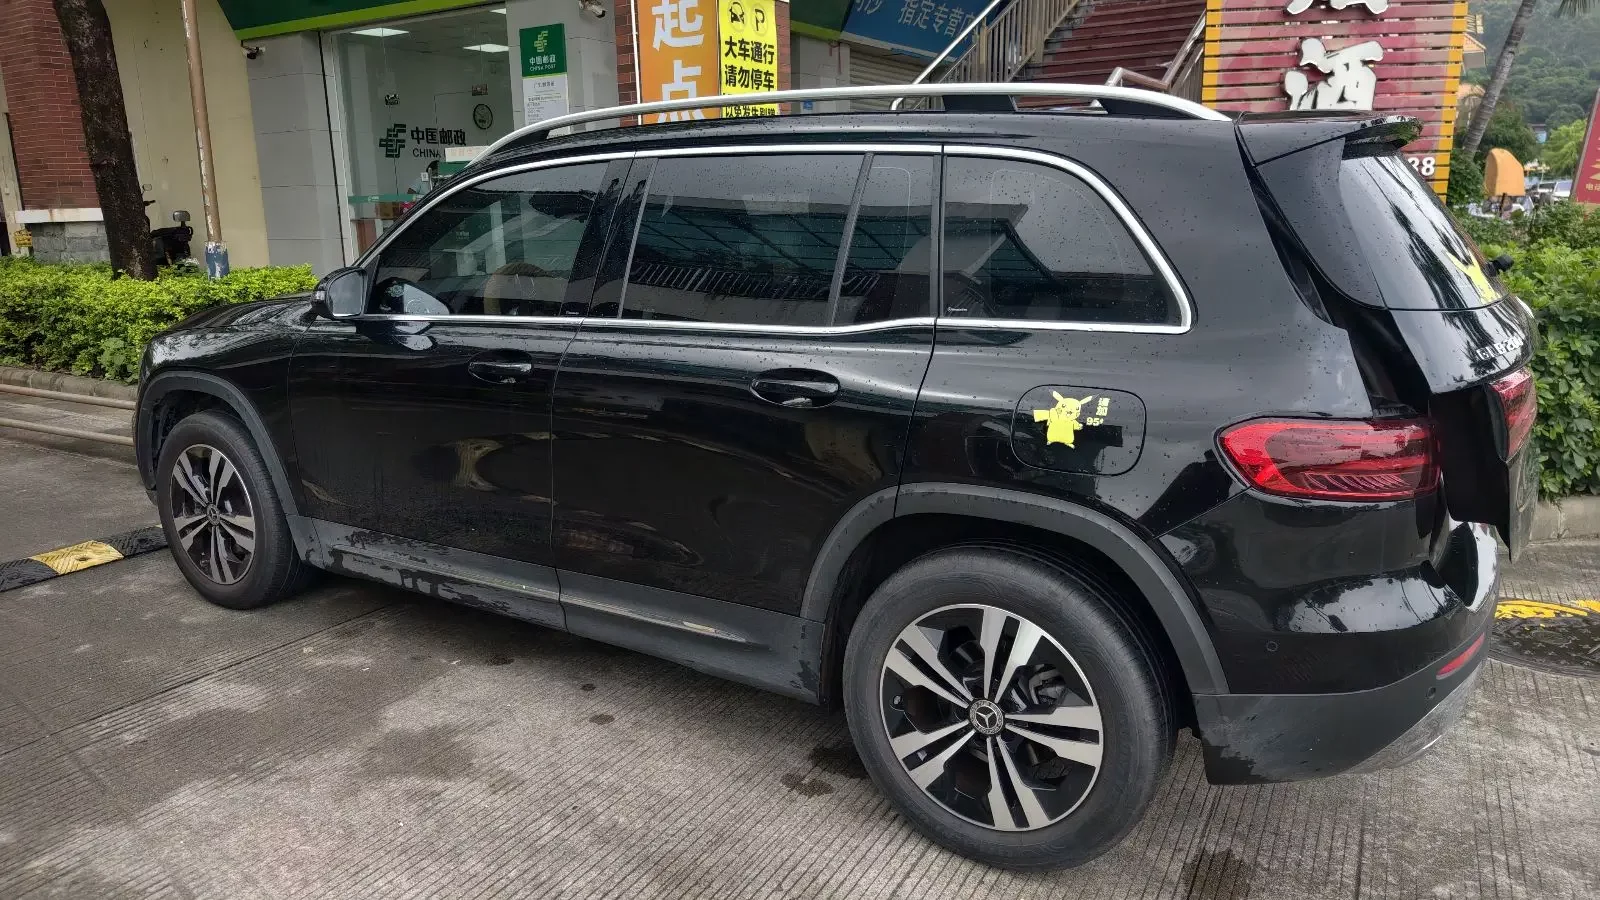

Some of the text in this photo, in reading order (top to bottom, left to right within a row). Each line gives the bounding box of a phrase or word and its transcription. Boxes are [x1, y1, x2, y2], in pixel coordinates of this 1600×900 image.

[529, 54, 556, 65] 中国邮政
[651, 0, 705, 122] 起点
[724, 36, 775, 65] 大车通行
[724, 64, 775, 91] 请勿停车
[410, 126, 467, 146] 中国邮政
[412, 148, 441, 158] CHINA
